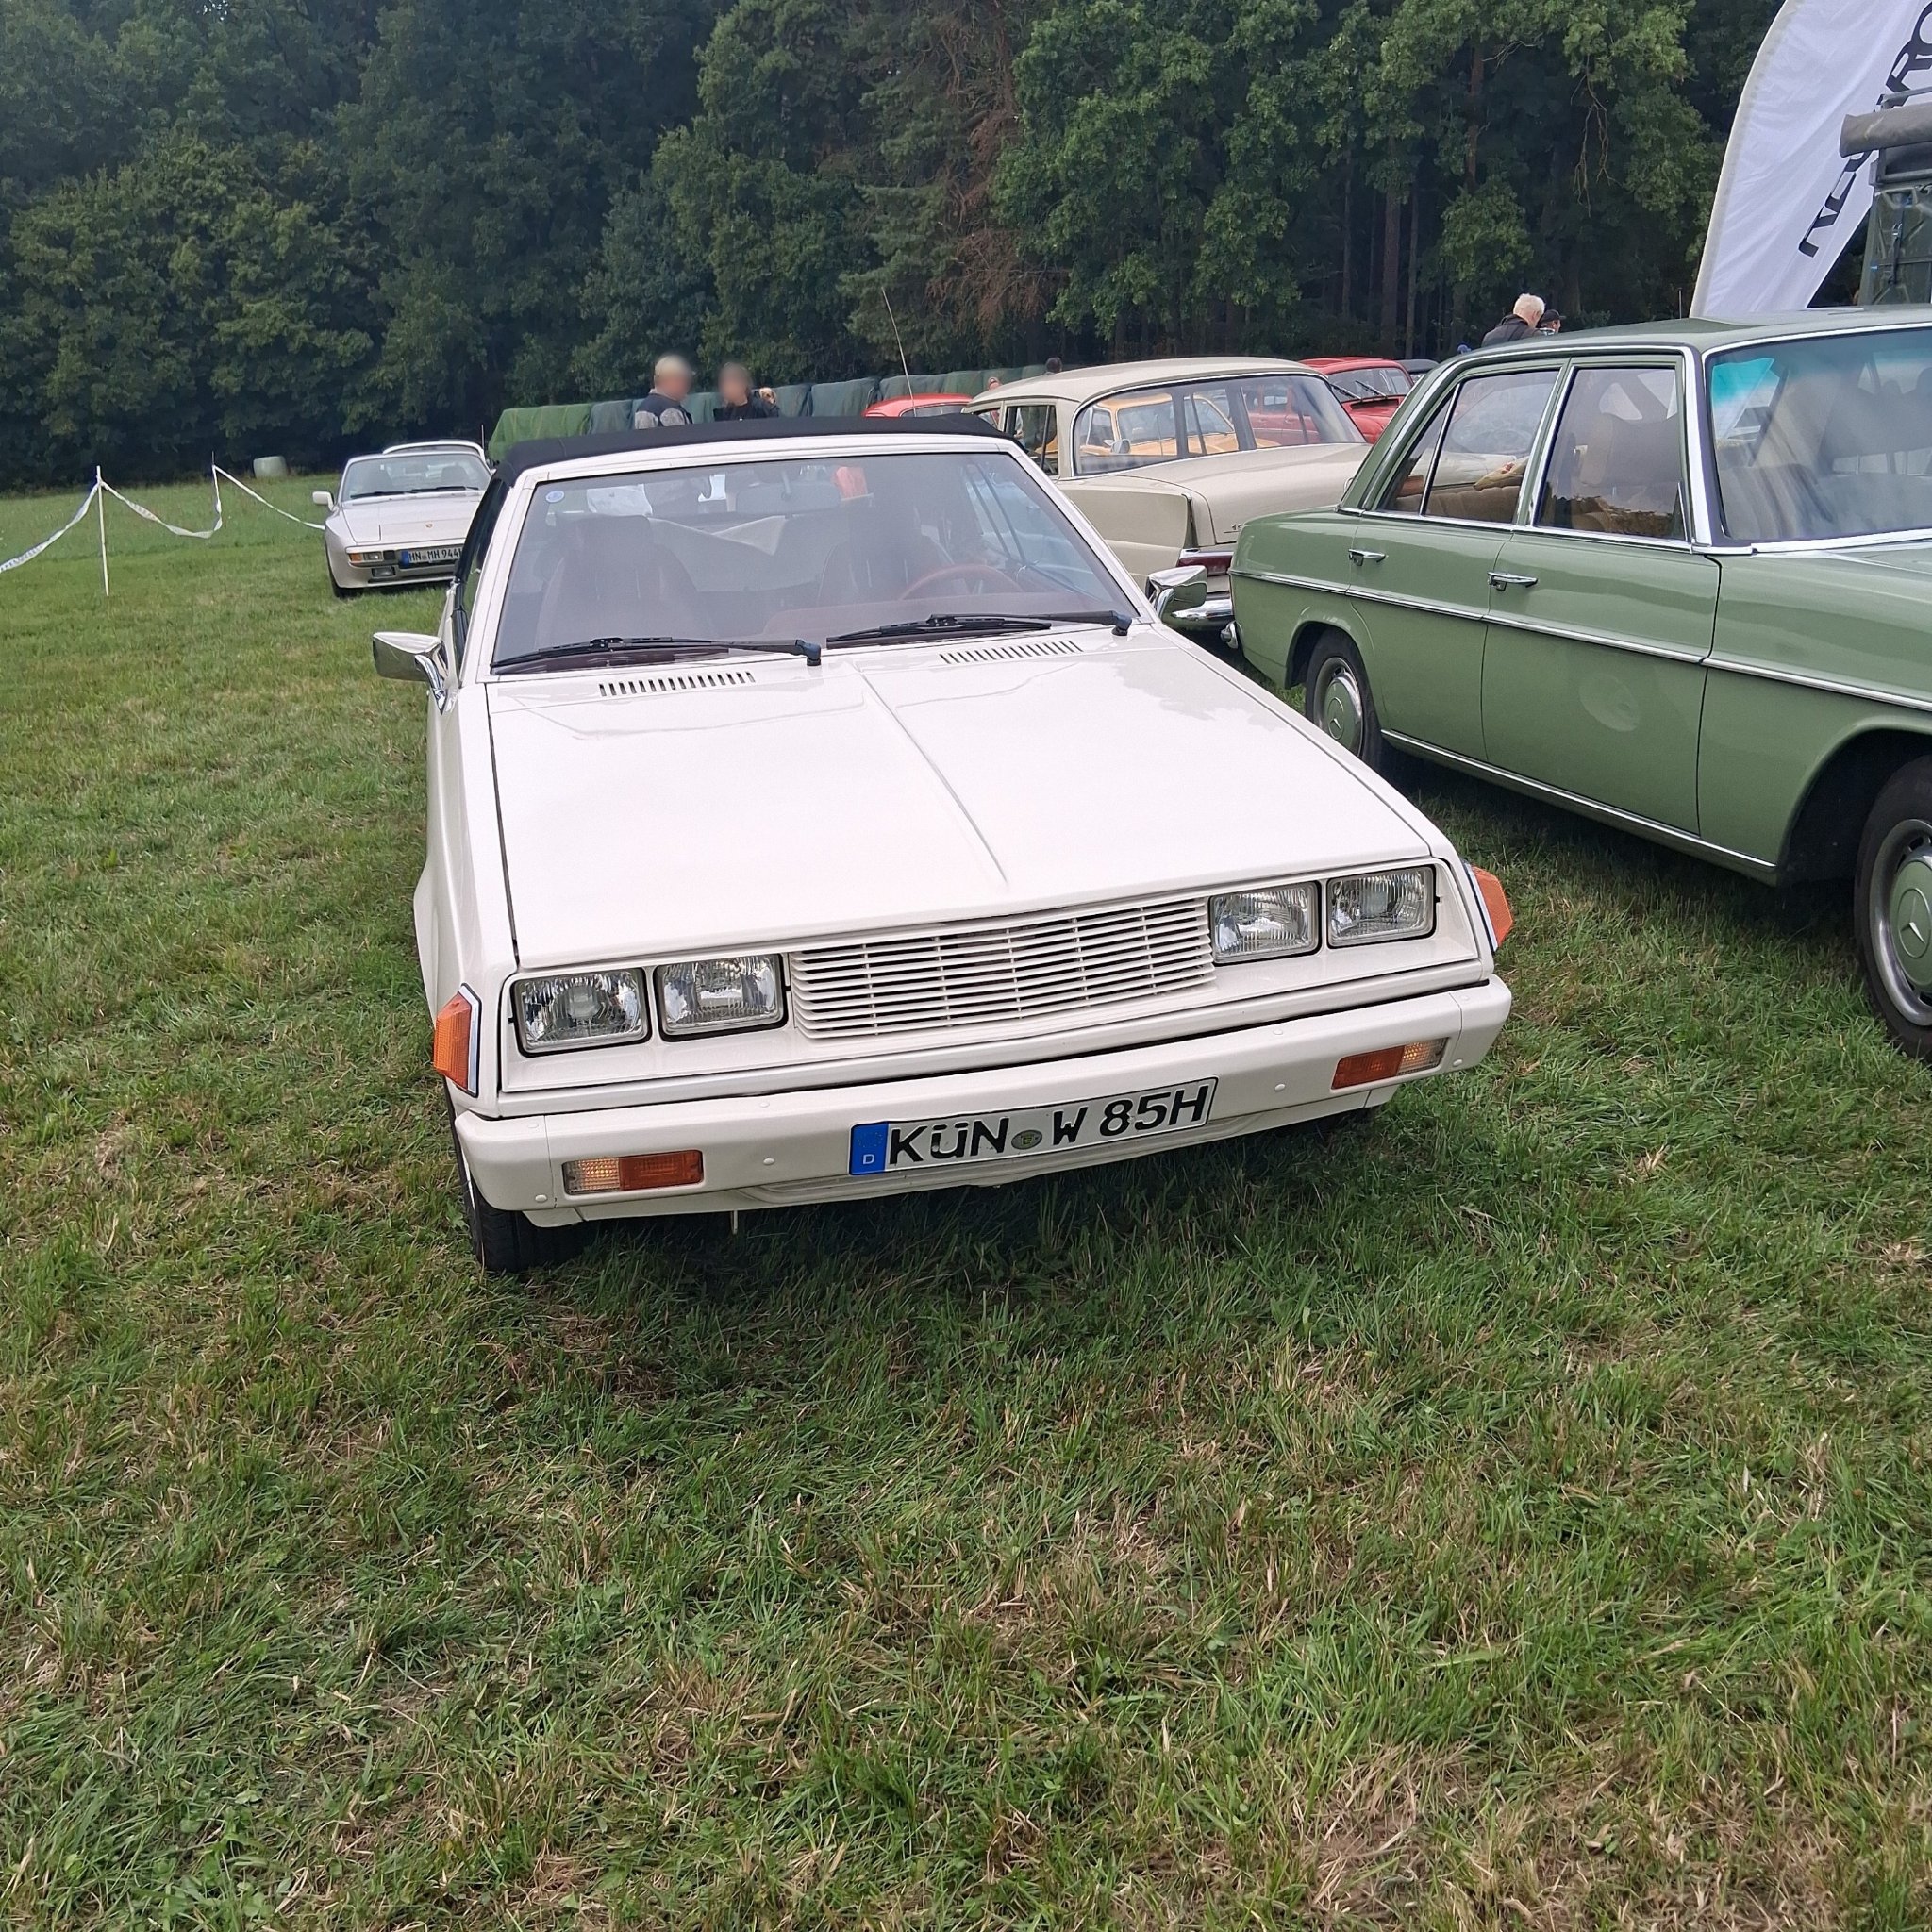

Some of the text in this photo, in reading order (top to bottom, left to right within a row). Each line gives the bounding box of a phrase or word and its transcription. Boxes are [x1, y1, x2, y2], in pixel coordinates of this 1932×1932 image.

[408, 551, 422, 562] HN
[427, 549, 441, 560] MH
[889, 1085, 1209, 1165] KÜN W 85H
[862, 1154, 875, 1165] D
